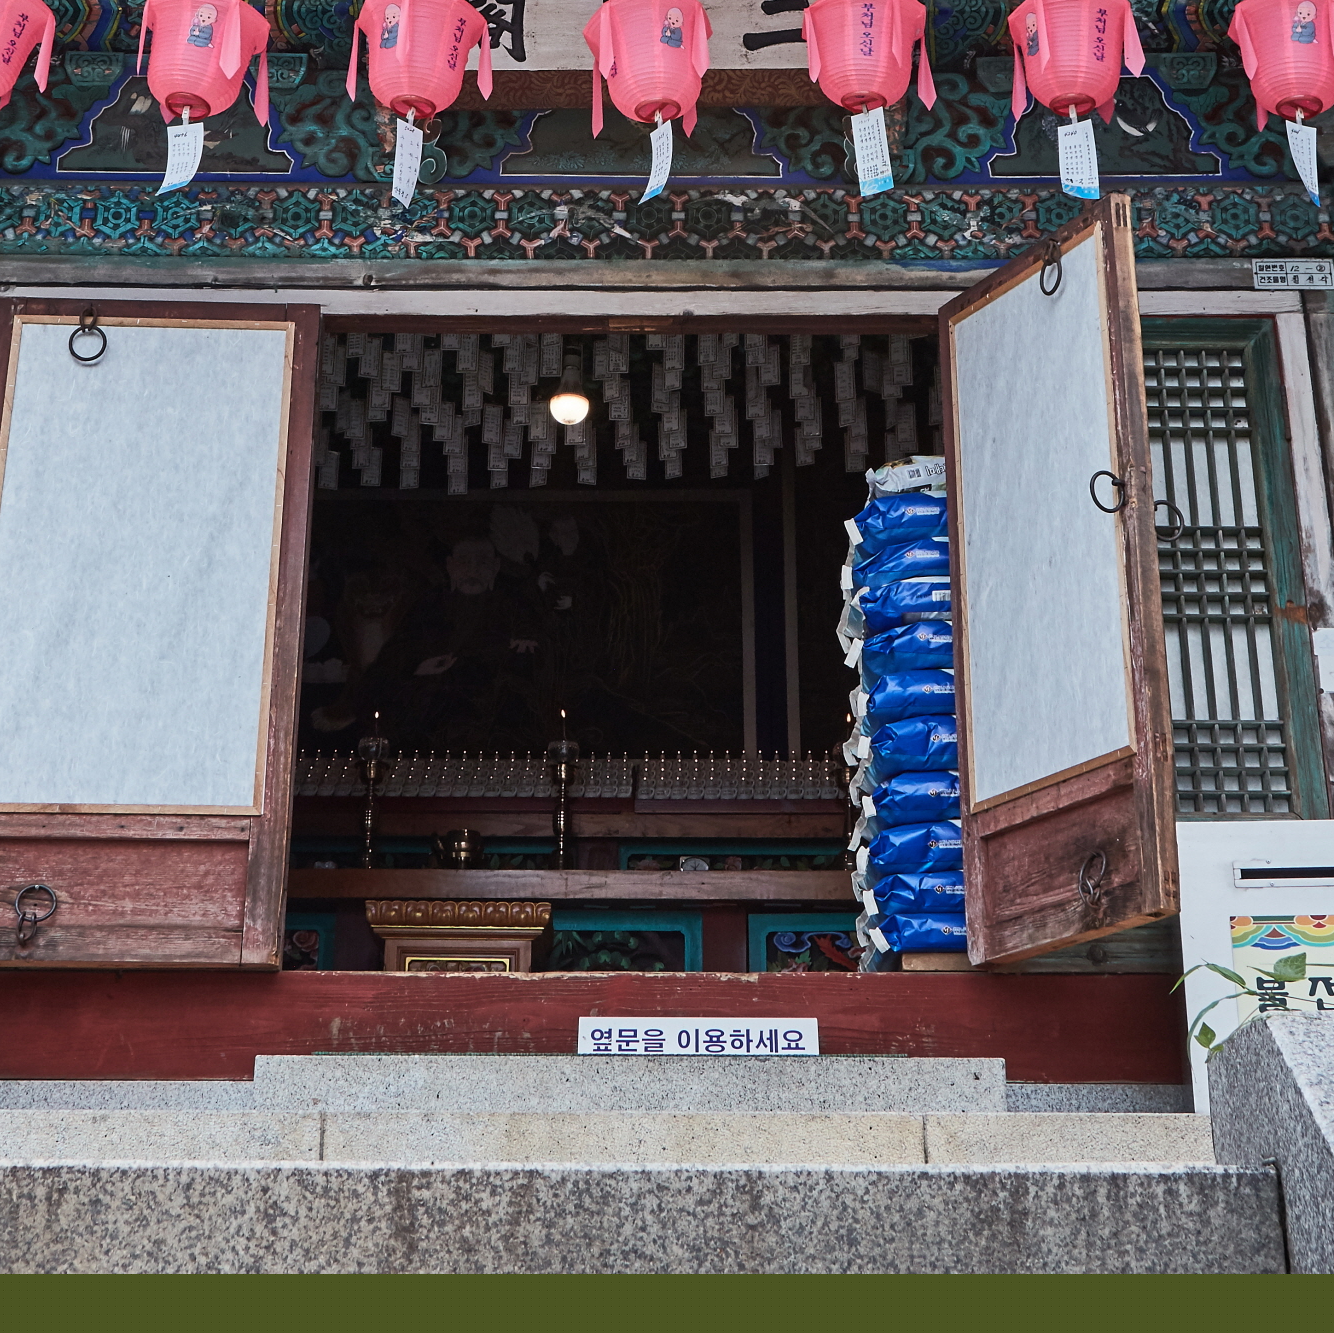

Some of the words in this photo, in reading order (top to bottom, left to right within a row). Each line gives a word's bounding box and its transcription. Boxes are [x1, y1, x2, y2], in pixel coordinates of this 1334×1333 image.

[12, 12, 30, 39] 부처님
[861, 2, 876, 29] 부처님
[1095, 7, 1108, 35] 부처님
[452, 17, 467, 44] 부처님
[859, 31, 875, 57] 오신날
[1092, 36, 1107, 63] 오신날
[590, 1028, 666, 1053] 옆문을
[677, 1028, 806, 1054] 이용하세요
